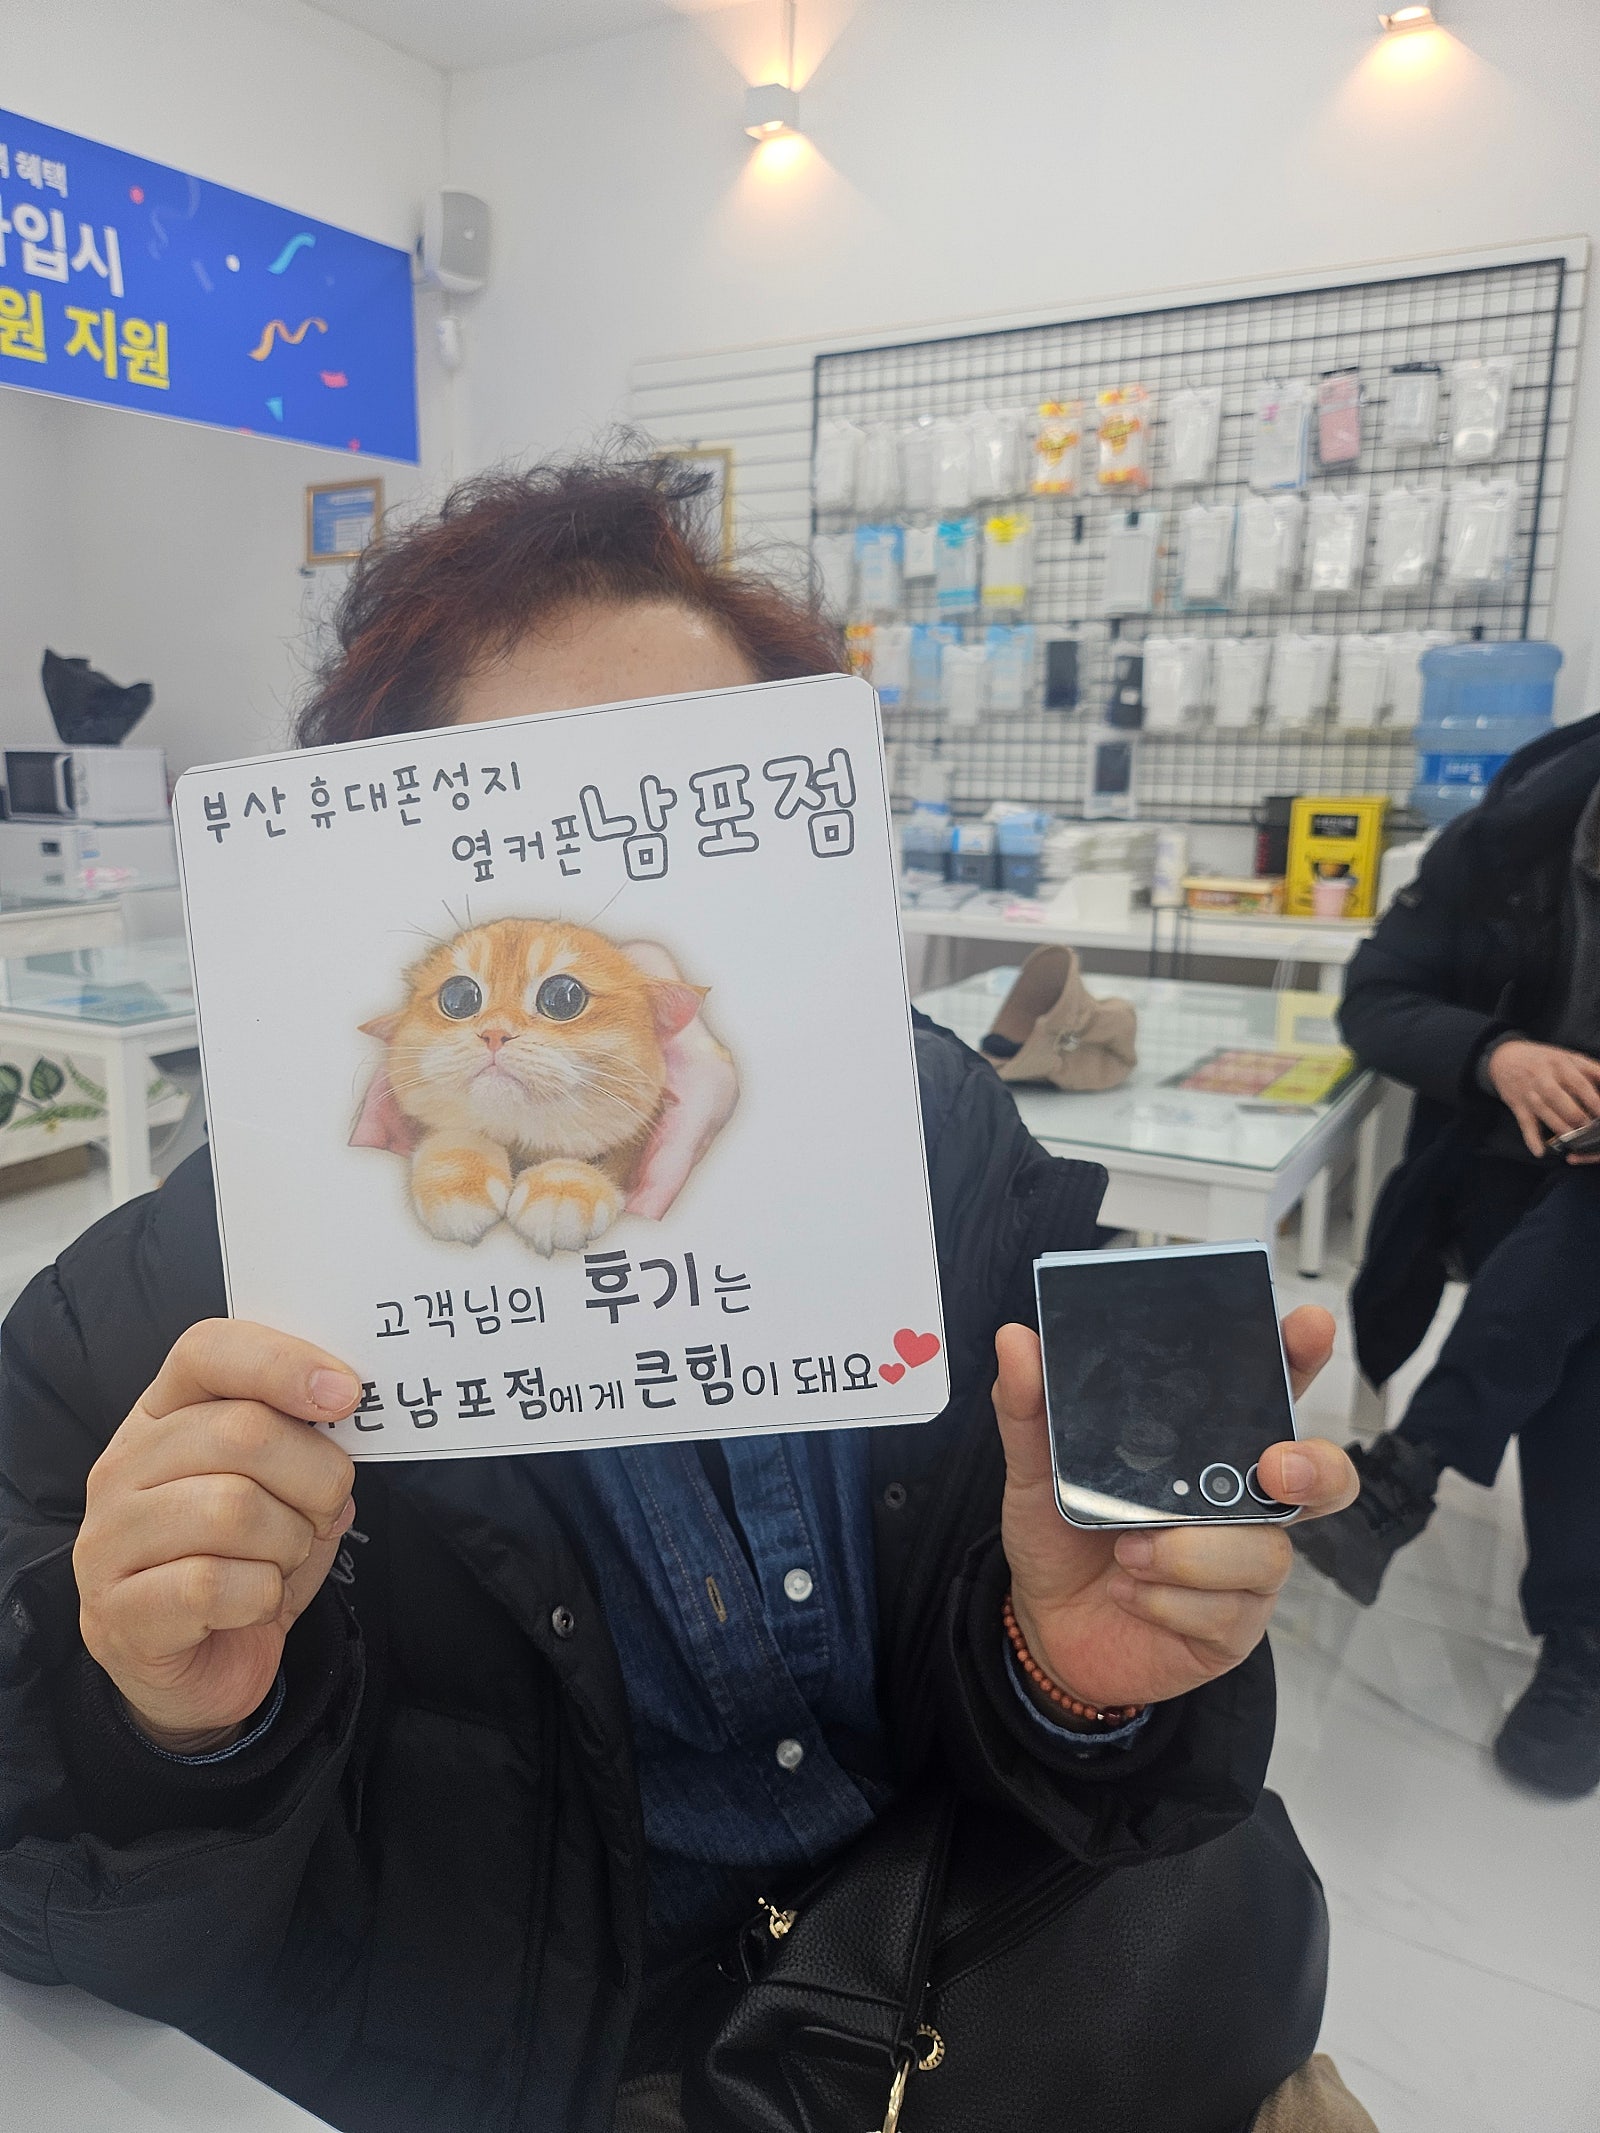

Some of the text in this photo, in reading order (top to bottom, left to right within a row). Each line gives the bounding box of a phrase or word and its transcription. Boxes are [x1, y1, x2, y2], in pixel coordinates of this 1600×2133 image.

[15, 150, 69, 199] 혜택
[64, 304, 171, 391] 지원
[203, 786, 286, 844] 부산
[376, 1285, 545, 1339] 고객님의
[792, 1352, 879, 1397] 돼요
